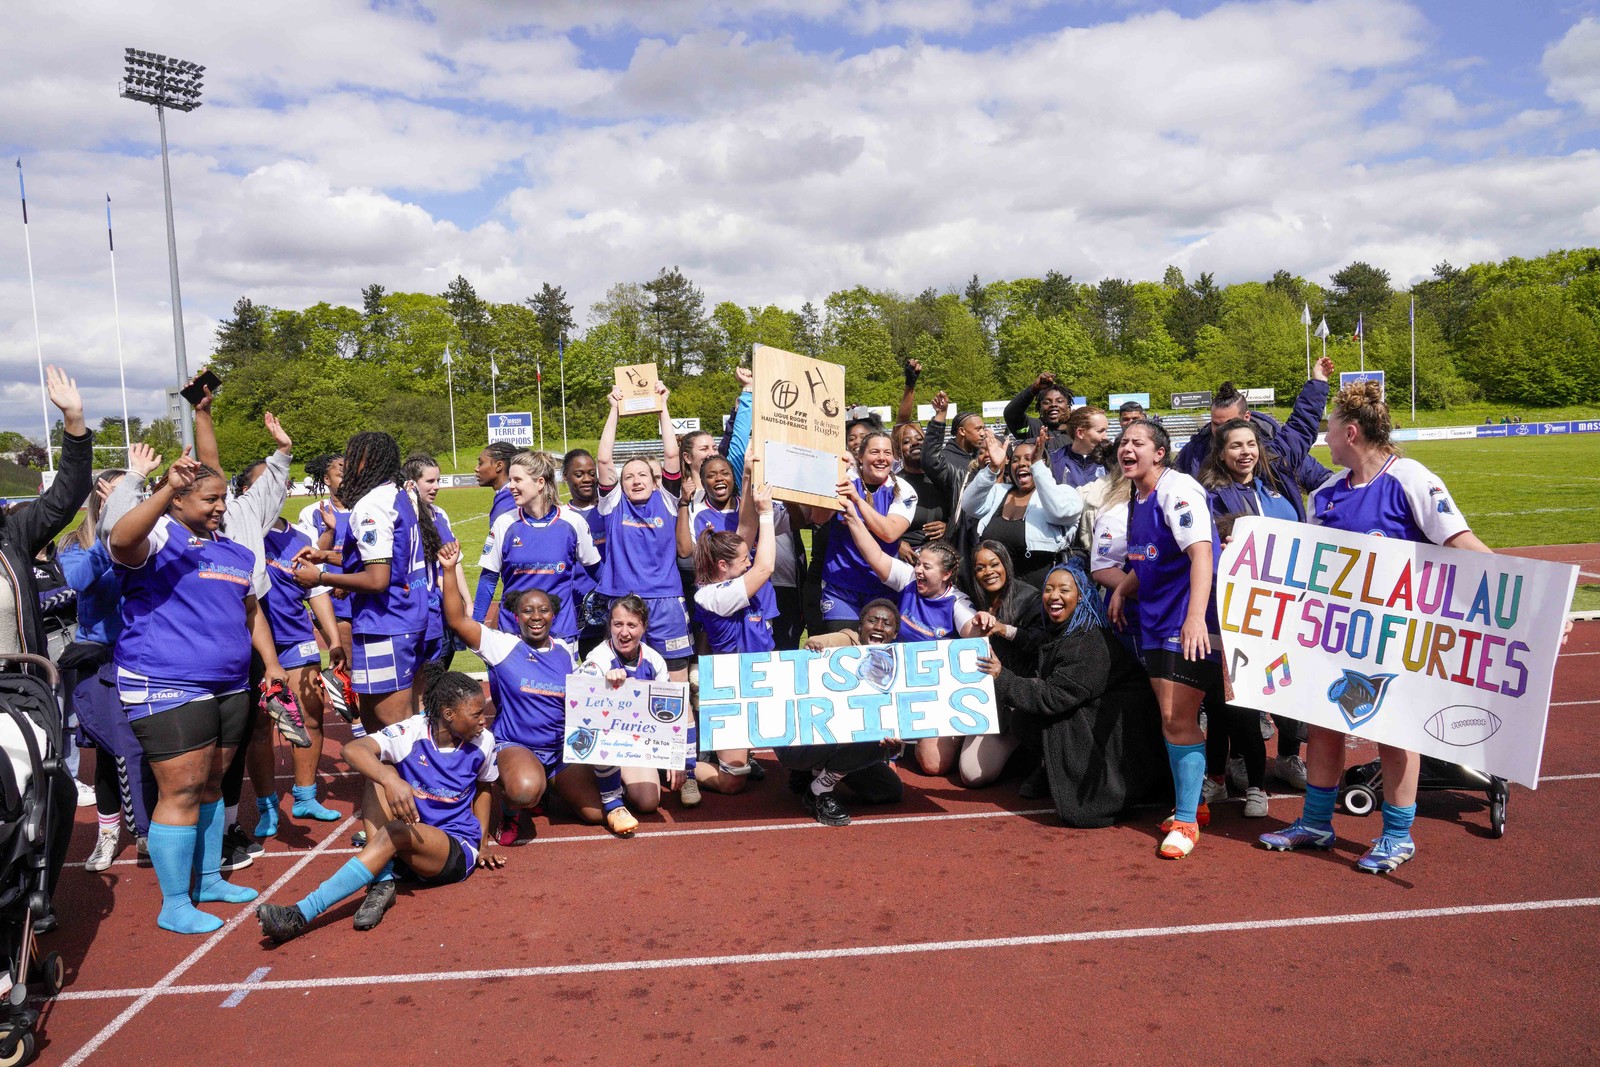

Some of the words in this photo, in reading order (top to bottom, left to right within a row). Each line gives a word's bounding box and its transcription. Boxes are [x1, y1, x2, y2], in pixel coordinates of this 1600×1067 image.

[773, 412, 789, 420] LIGUE
[789, 415, 808, 424] RUGBY
[794, 410, 808, 418] FFR
[761, 415, 808, 430] HAUTS-DE-FRANCE
[495, 428, 517, 436] TERRE
[517, 427, 526, 435] DE
[814, 426, 840, 437] Rugby
[1228, 530, 1361, 600] ALLEZ
[1375, 613, 1531, 698] FURIES
[699, 645, 862, 701] LET'S
[903, 636, 990, 688] GO
[585, 697, 614, 708] Let's
[617, 701, 633, 710] go
[610, 718, 657, 733] Furies
[699, 686, 990, 751] FURIES
